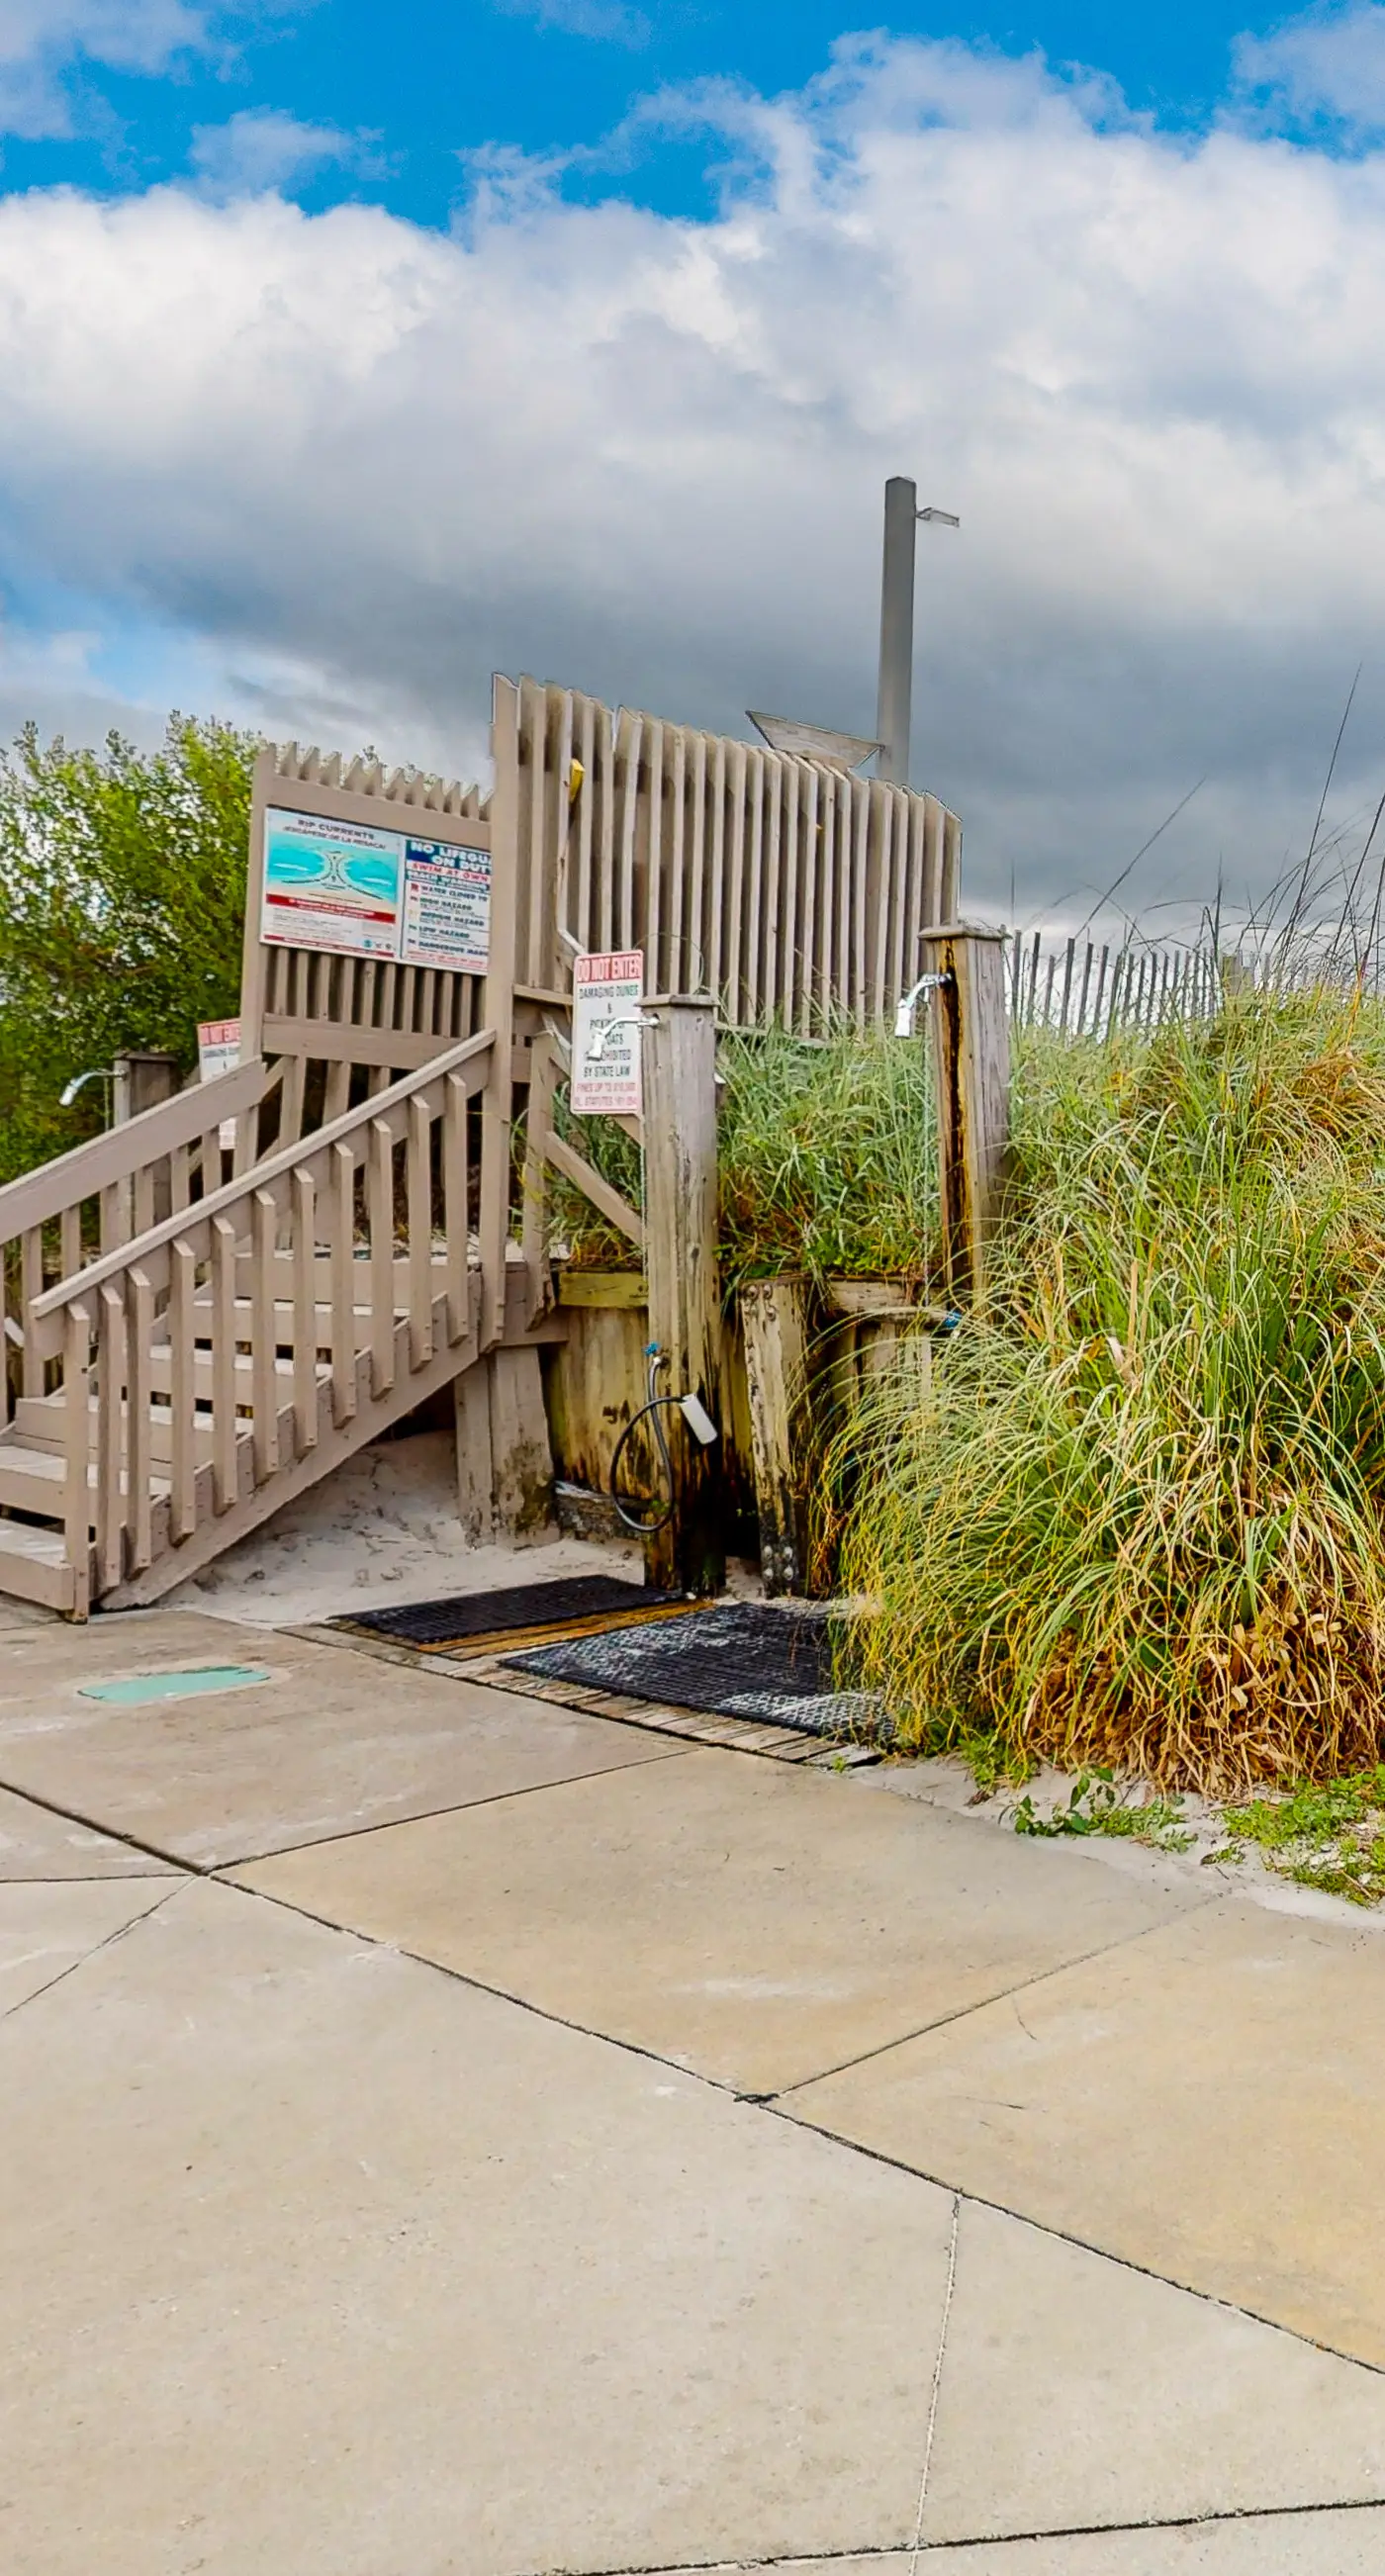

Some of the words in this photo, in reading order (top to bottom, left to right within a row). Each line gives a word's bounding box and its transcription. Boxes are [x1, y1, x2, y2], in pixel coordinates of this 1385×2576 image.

[319, 823, 374, 840] CURRENTS
[411, 841, 435, 854] NO
[431, 855, 456, 867] ON
[413, 862, 441, 873] SWIM
[463, 873, 489, 882] OWN
[578, 960, 591, 982] DO
[592, 958, 610, 981] NOT
[611, 955, 641, 979] ENTER
[579, 986, 614, 999] DAMAGING
[584, 1066, 593, 1078] BY
[594, 1065, 613, 1077] STATE
[615, 1064, 630, 1076] LAW
